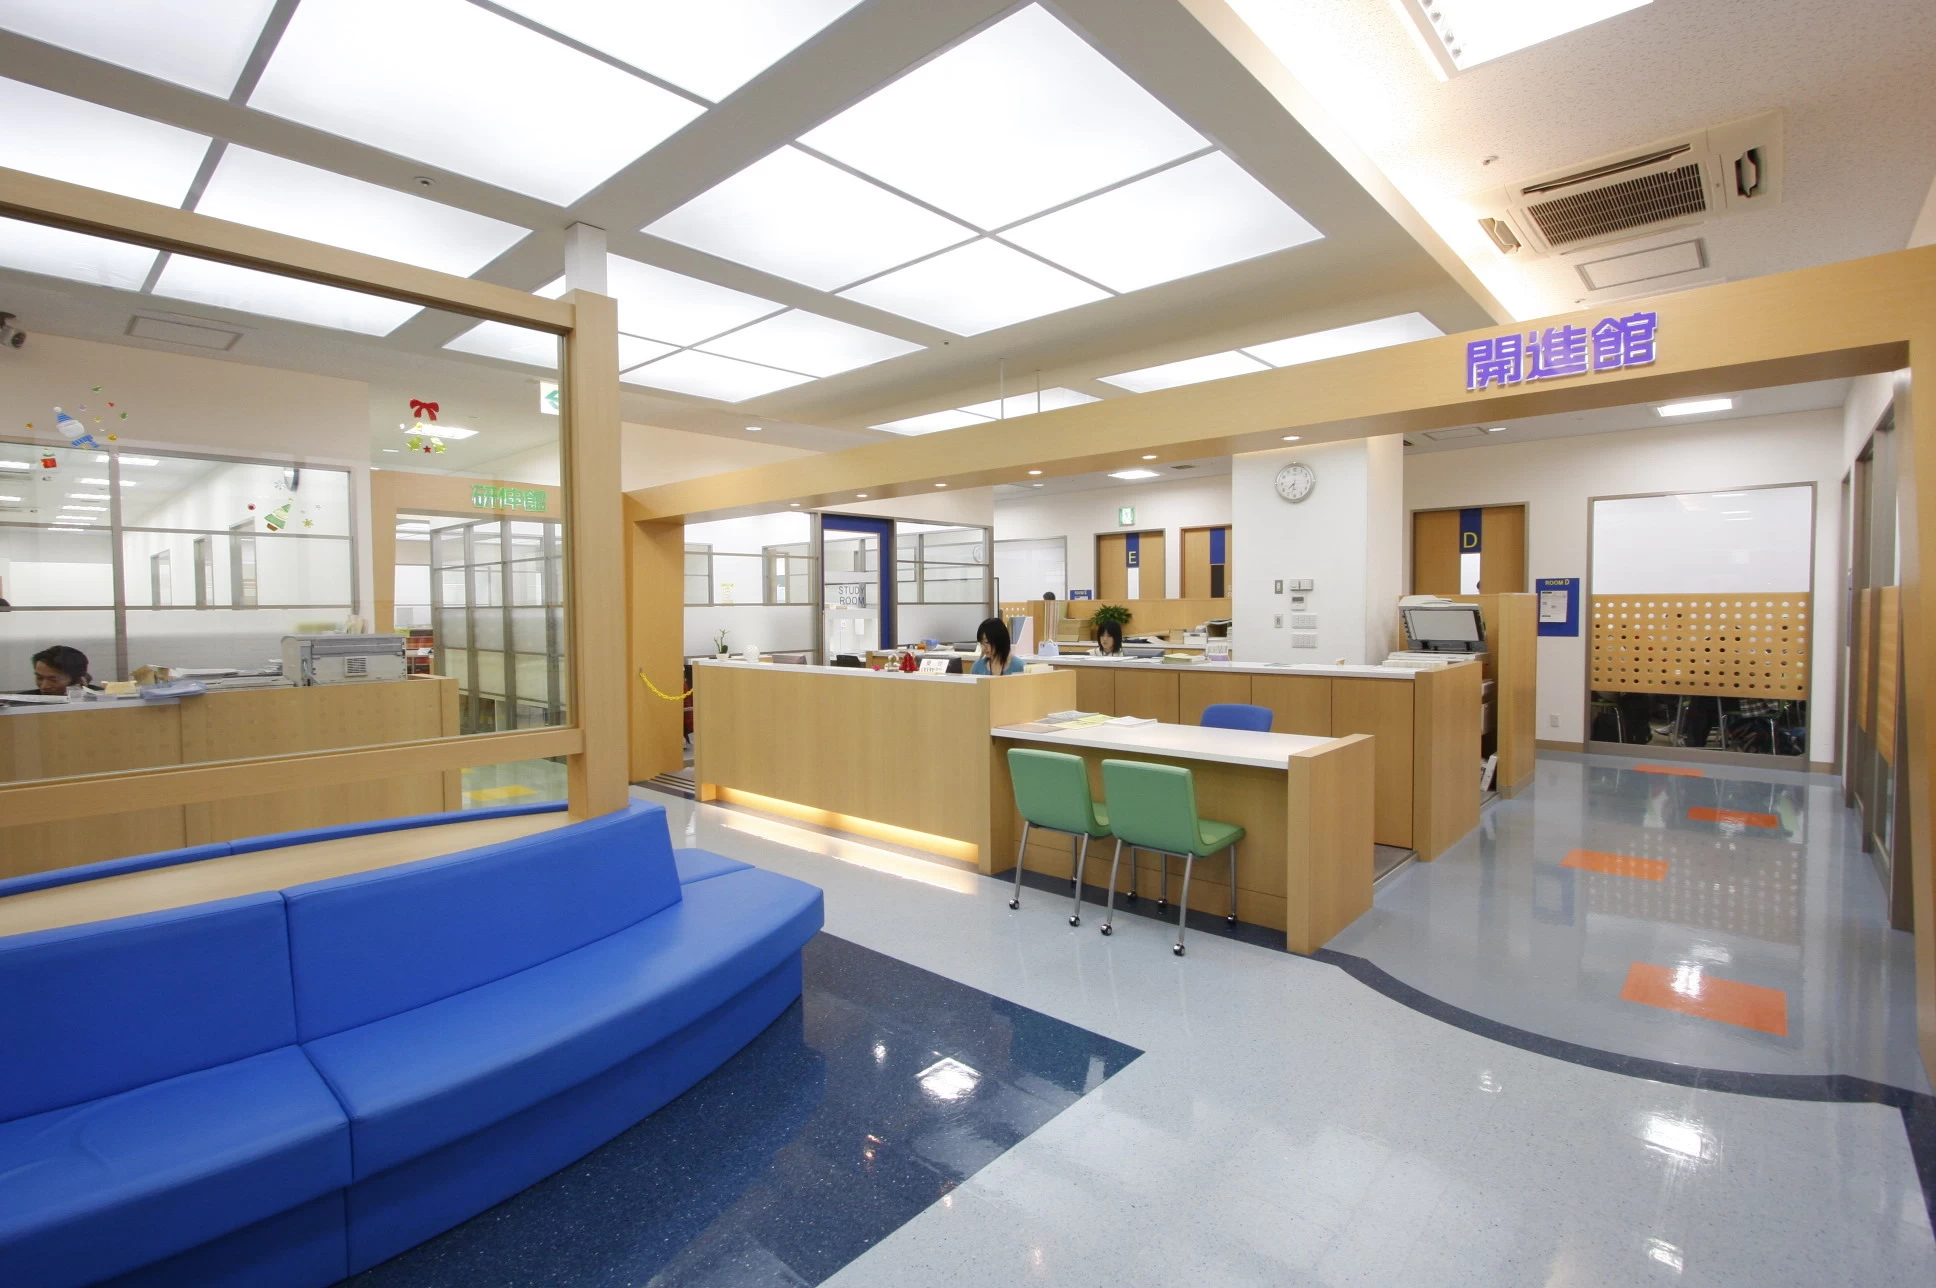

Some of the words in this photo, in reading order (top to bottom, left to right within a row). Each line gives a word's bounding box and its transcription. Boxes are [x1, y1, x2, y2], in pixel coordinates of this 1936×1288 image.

[1467, 312, 1657, 389] 開進館
[471, 484, 547, 512] 研伸館
[1463, 532, 1478, 548] D
[1128, 551, 1137, 564] E
[838, 586, 865, 595] STUDY
[840, 597, 865, 605] ROOM
